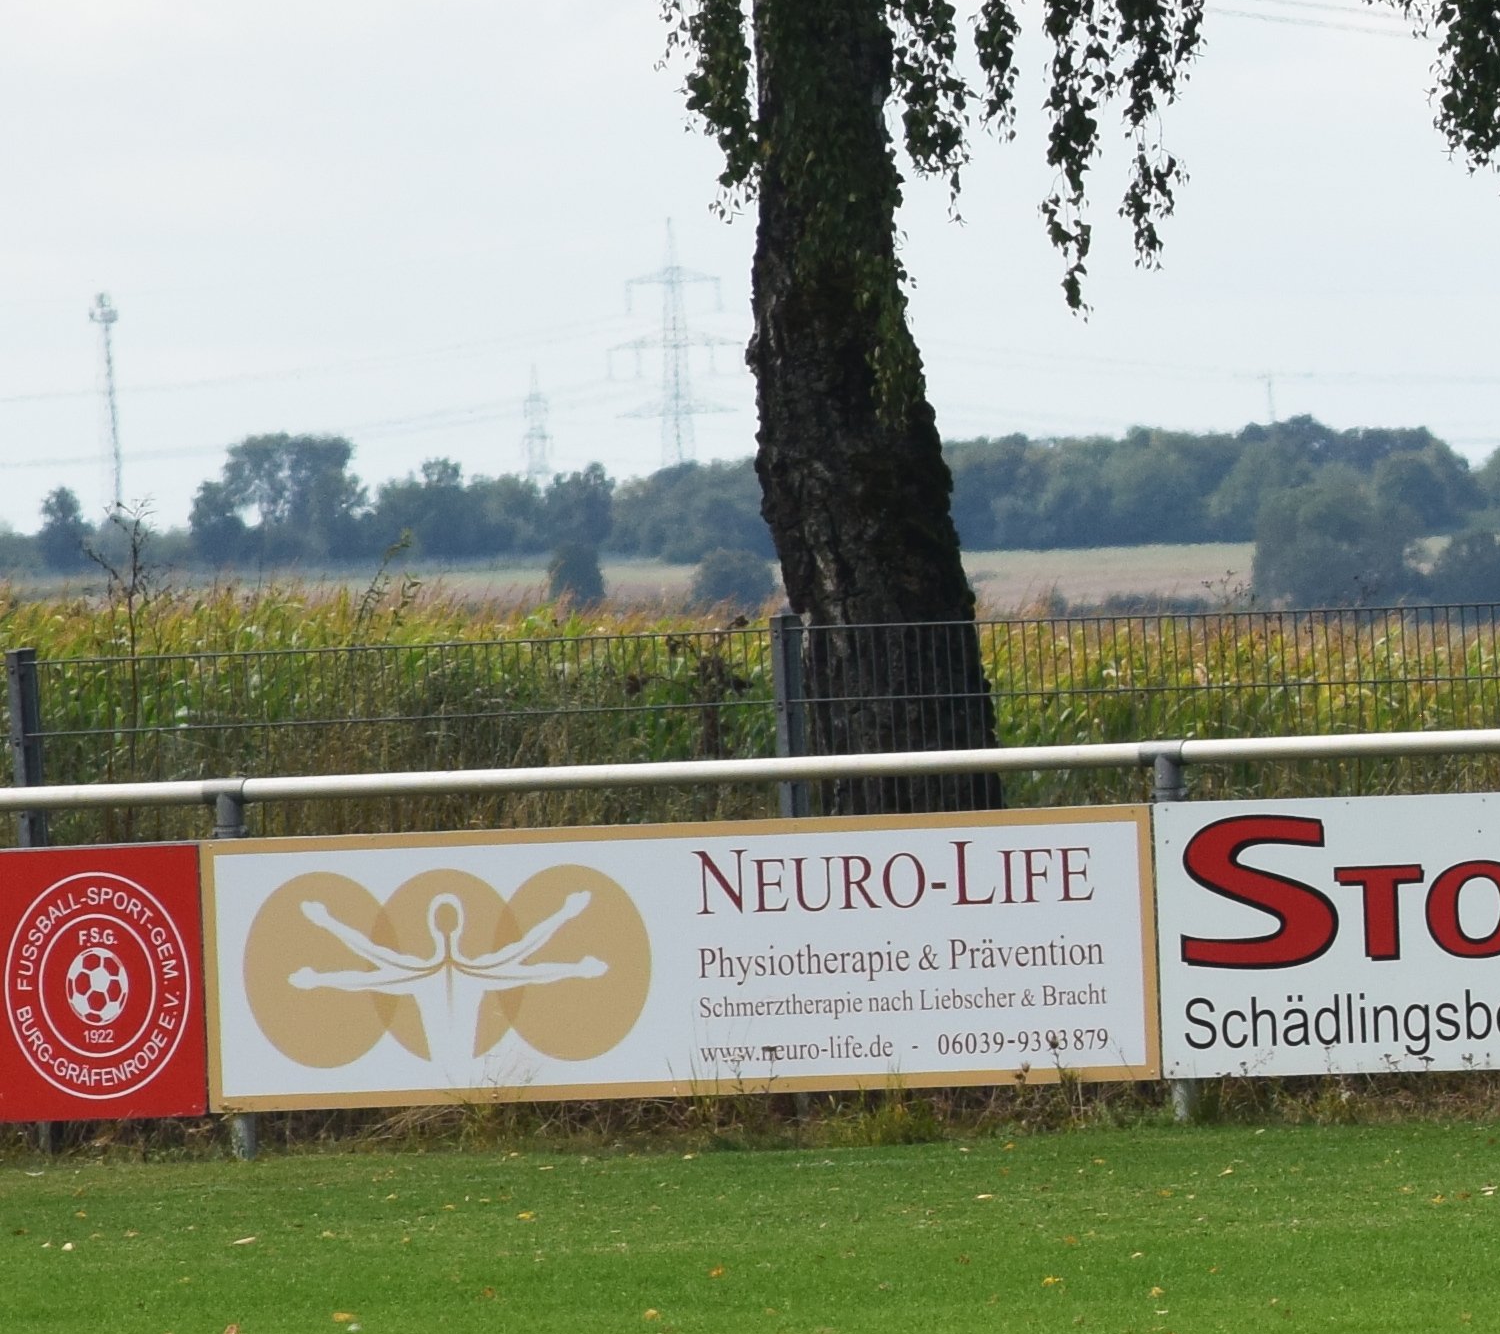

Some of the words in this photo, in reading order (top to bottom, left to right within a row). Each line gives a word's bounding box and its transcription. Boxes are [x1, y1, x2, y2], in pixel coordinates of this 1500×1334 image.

[692, 841, 1095, 915] NEURO-LIFE
[79, 927, 118, 946] F.S.G.
[698, 941, 910, 985] Physiotherapie
[918, 945, 940, 971] &
[949, 935, 1105, 971] Prävention
[699, 993, 863, 1019] Schmerztherapie
[868, 989, 914, 1013] nach
[919, 986, 1016, 1011] Liebscher
[1020, 988, 1036, 1008] &
[1042, 983, 1107, 1007] Bracht
[83, 1029, 114, 1044] 1922
[700, 1034, 894, 1063] www.neuro-life.de
